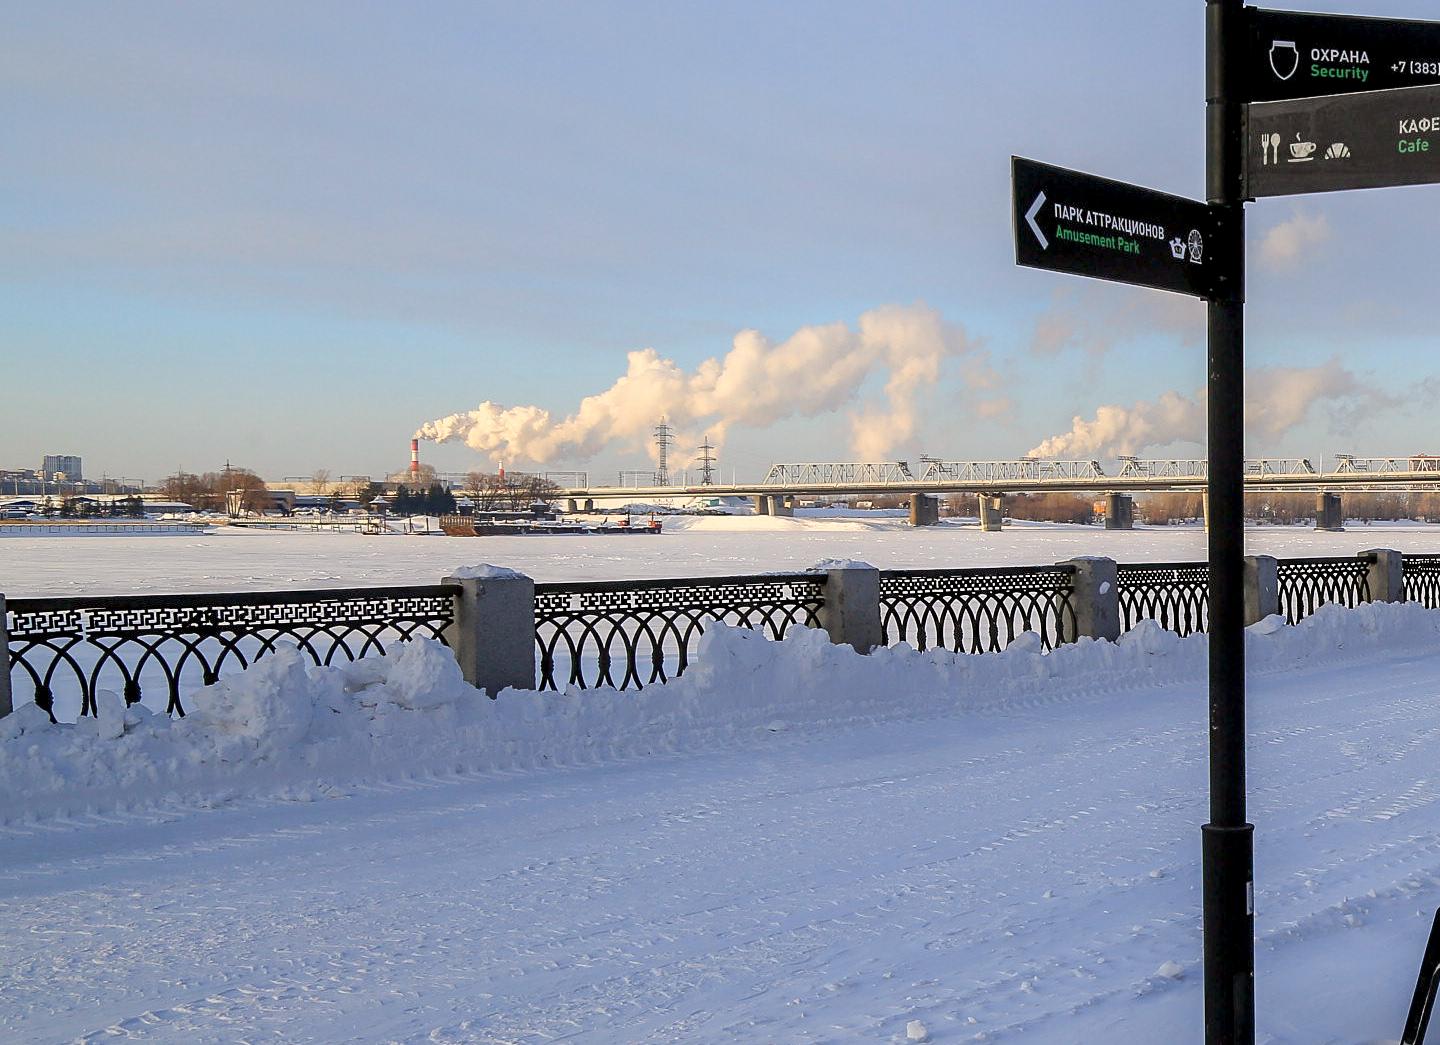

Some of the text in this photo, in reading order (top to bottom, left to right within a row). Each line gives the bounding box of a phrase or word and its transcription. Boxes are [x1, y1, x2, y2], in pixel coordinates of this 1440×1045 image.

[1311, 48, 1370, 64] ОХРАНА
[1310, 64, 1369, 82] Security
[1391, 61, 1406, 73] +7
[1399, 117, 1440, 134] КАФЕ
[1398, 139, 1430, 154] Cafe
[1054, 202, 1165, 240] ПАРК АТТРАКЦИОНОВ
[1055, 225, 1141, 254] Amusement Park
